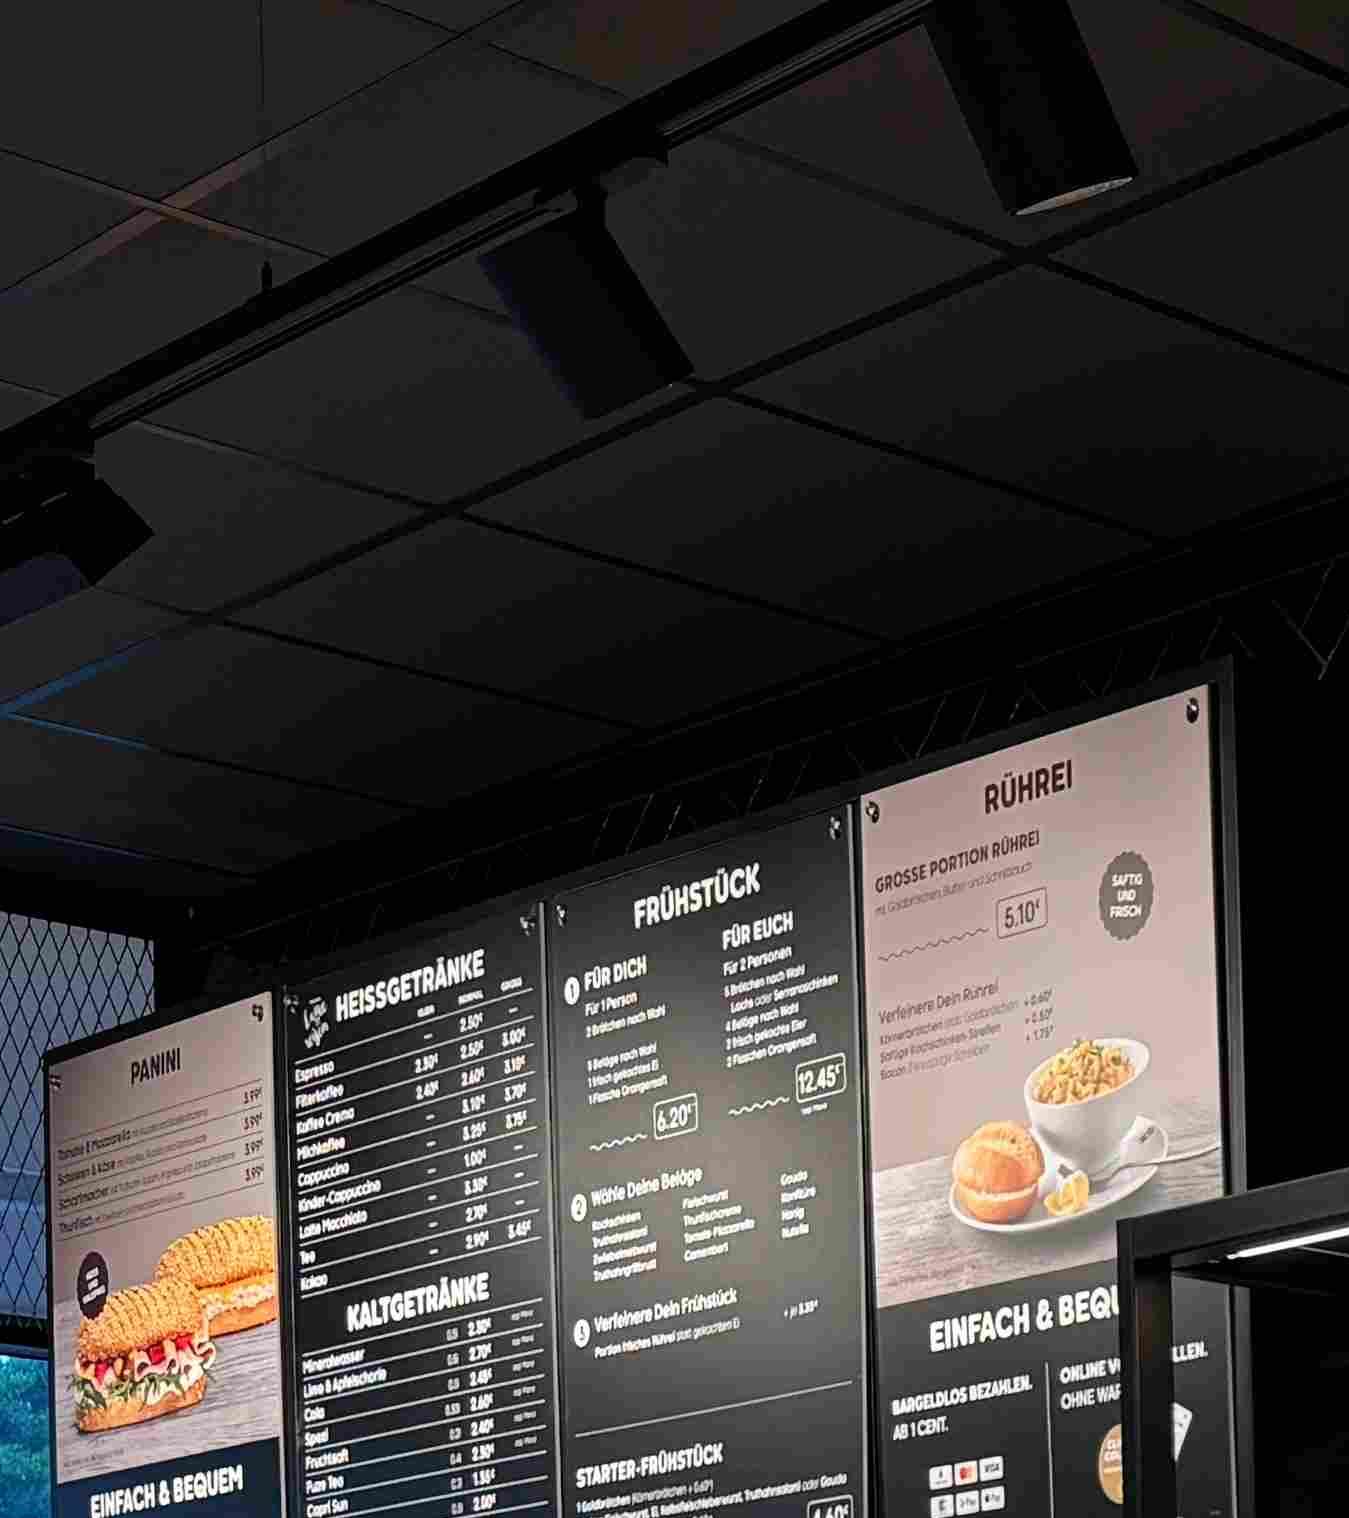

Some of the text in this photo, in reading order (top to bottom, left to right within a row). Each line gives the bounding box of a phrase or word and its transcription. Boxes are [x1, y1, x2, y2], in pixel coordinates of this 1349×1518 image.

[984, 759, 1072, 814] RÜHREI
[875, 830, 1040, 893] GROSSE PORTION RÜHREI
[634, 862, 760, 929] FRÜHSTÜCK
[1111, 872, 1143, 888] SAFTIG
[1118, 889, 1136, 902] UND
[1109, 904, 1142, 919] FRISCH
[722, 911, 793, 950] FÜR EUCH
[584, 955, 647, 991] FÜR DICH
[723, 960, 738, 976] Für
[747, 946, 792, 968] Personen
[335, 948, 485, 1022] HEISSGETRÄNKE
[878, 976, 1000, 1025] Verfeinere Dein Rührei
[585, 992, 637, 1016] Für Person
[131, 1048, 180, 1084] PANINI
[295, 1060, 334, 1083] Espresso
[298, 1161, 350, 1187] Cappuccino
[591, 1167, 703, 1207] Wähle Deine Beläge
[322, 1210, 368, 1233] Macchiato
[346, 1271, 489, 1332] KALTGETRÄNKE
[594, 1287, 737, 1333] Verfeinere Dein Frühstück
[929, 1298, 1054, 1353] EINFACH &
[1060, 1359, 1106, 1384] ONLINE
[892, 1374, 1033, 1416] BARGELDLOS BEZAHLEN.
[1060, 1390, 1096, 1411] OHNE
[304, 1406, 325, 1423] Cola
[893, 1415, 949, 1441] AB CENT.
[576, 1442, 723, 1489] STARTER-FRÜHSTÜCK
[158, 1480, 170, 1506] &
[173, 1464, 244, 1503] BEQUEM
